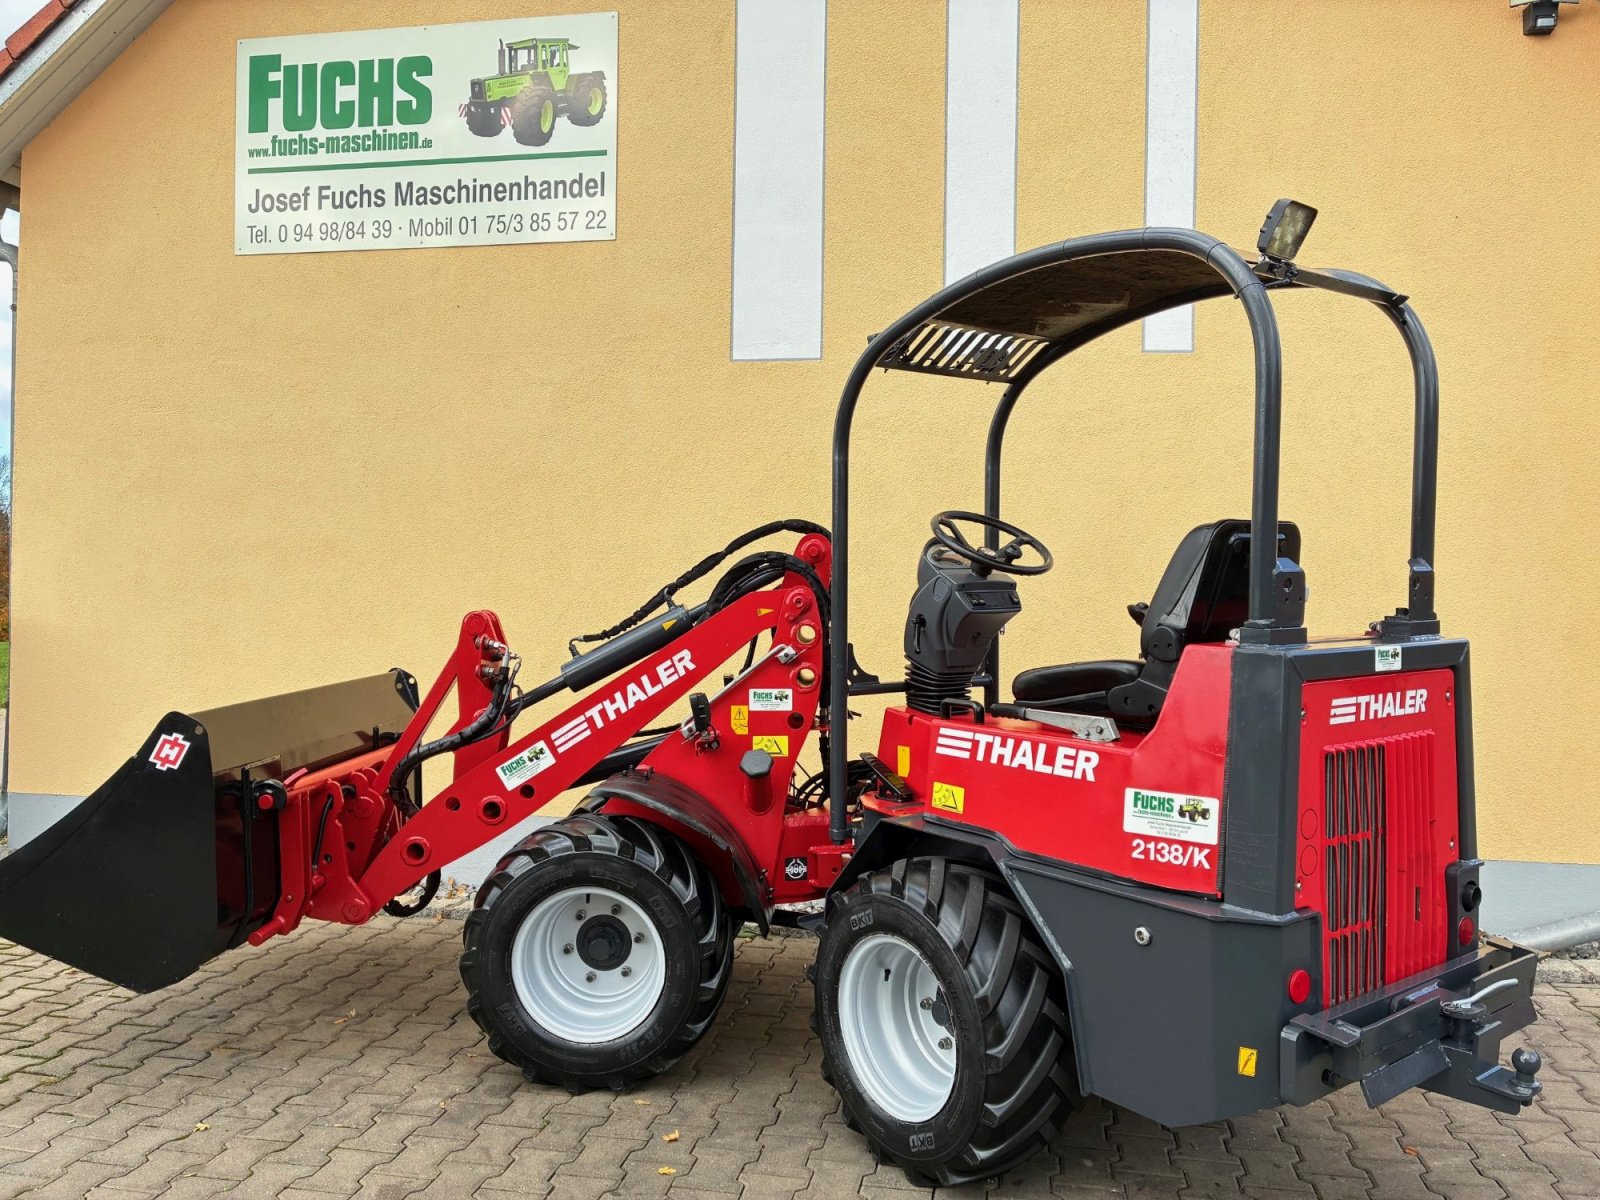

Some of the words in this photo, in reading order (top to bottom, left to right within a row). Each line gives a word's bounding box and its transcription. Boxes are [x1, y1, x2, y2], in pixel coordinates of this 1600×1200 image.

[248, 54, 433, 134] FUCHS
[248, 129, 433, 159] www.fuchs-maschinen.de
[247, 186, 310, 214] Josef
[318, 184, 386, 211] Fuchs
[394, 171, 605, 207] Maschinenhandel
[247, 225, 272, 244] Tel.
[278, 224, 288, 243] 0
[293, 223, 314, 242] 94
[319, 220, 366, 242] 98/84
[371, 219, 392, 239] 39
[409, 216, 453, 238] Mobil
[458, 215, 477, 236] 01
[486, 213, 524, 235] 75/3
[529, 212, 551, 232] 85
[557, 211, 579, 231] 57
[585, 210, 607, 230] 22
[584, 649, 697, 730] THALER
[753, 691, 773, 700] FUCHS
[1357, 688, 1428, 721] THALER
[500, 755, 527, 777] FUCHS
[973, 733, 1100, 782] THALER
[1133, 790, 1175, 813] FUCHS
[1131, 838, 1211, 870] 2138/K
[850, 908, 873, 931] BKT
[909, 1132, 936, 1153] BKT
